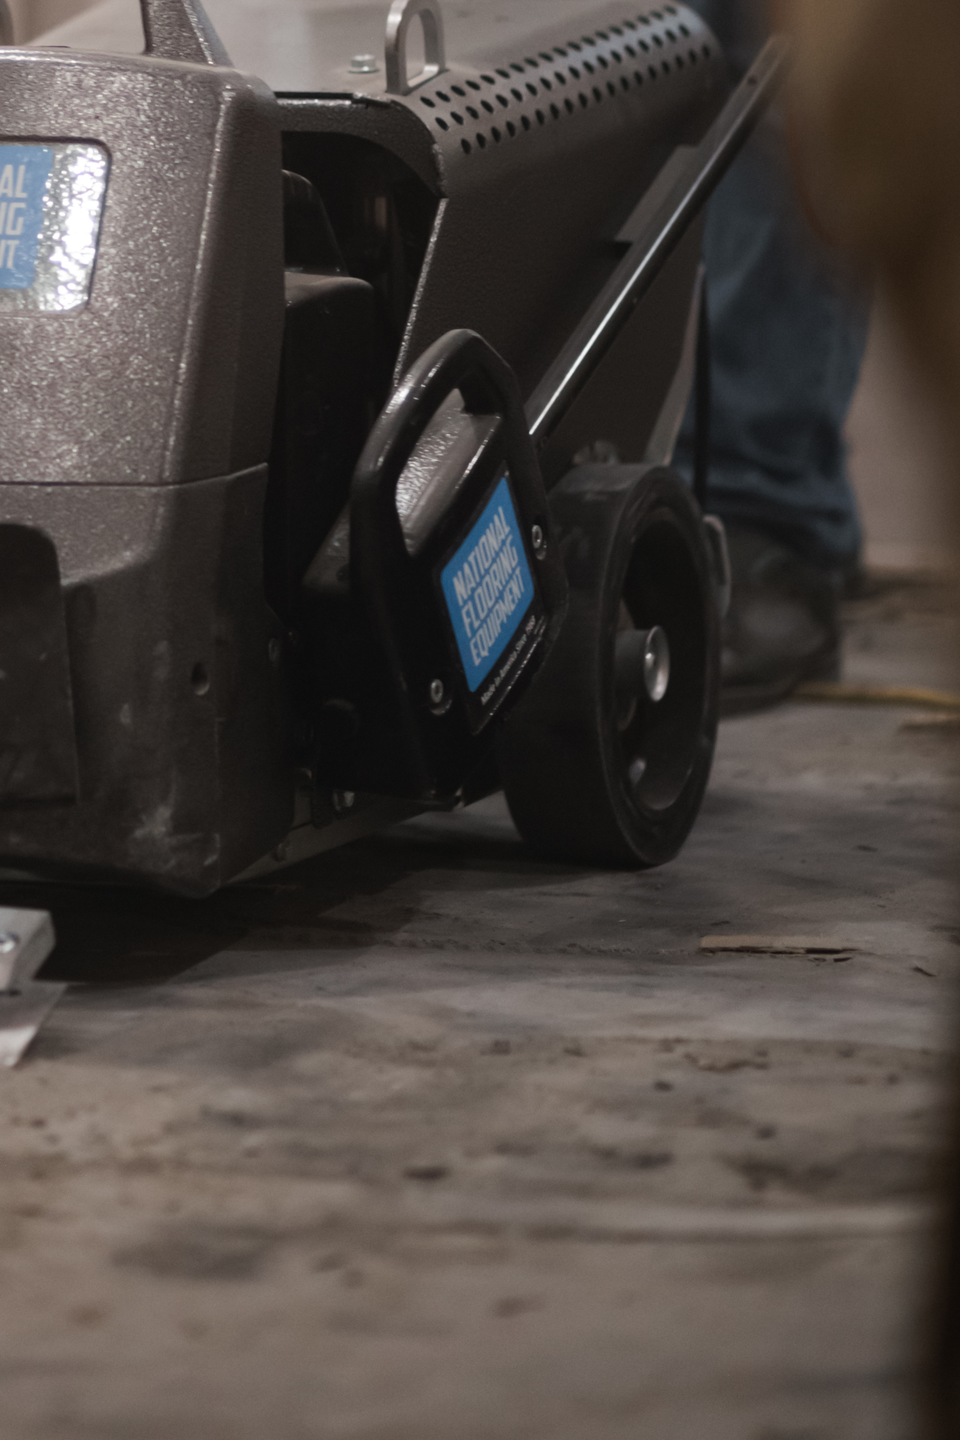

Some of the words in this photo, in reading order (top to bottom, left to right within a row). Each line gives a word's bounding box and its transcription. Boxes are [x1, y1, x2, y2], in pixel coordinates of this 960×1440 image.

[452, 506, 511, 606] NATIONAL
[461, 535, 519, 638] FLOORING
[469, 566, 525, 666] EQUIPMENT
